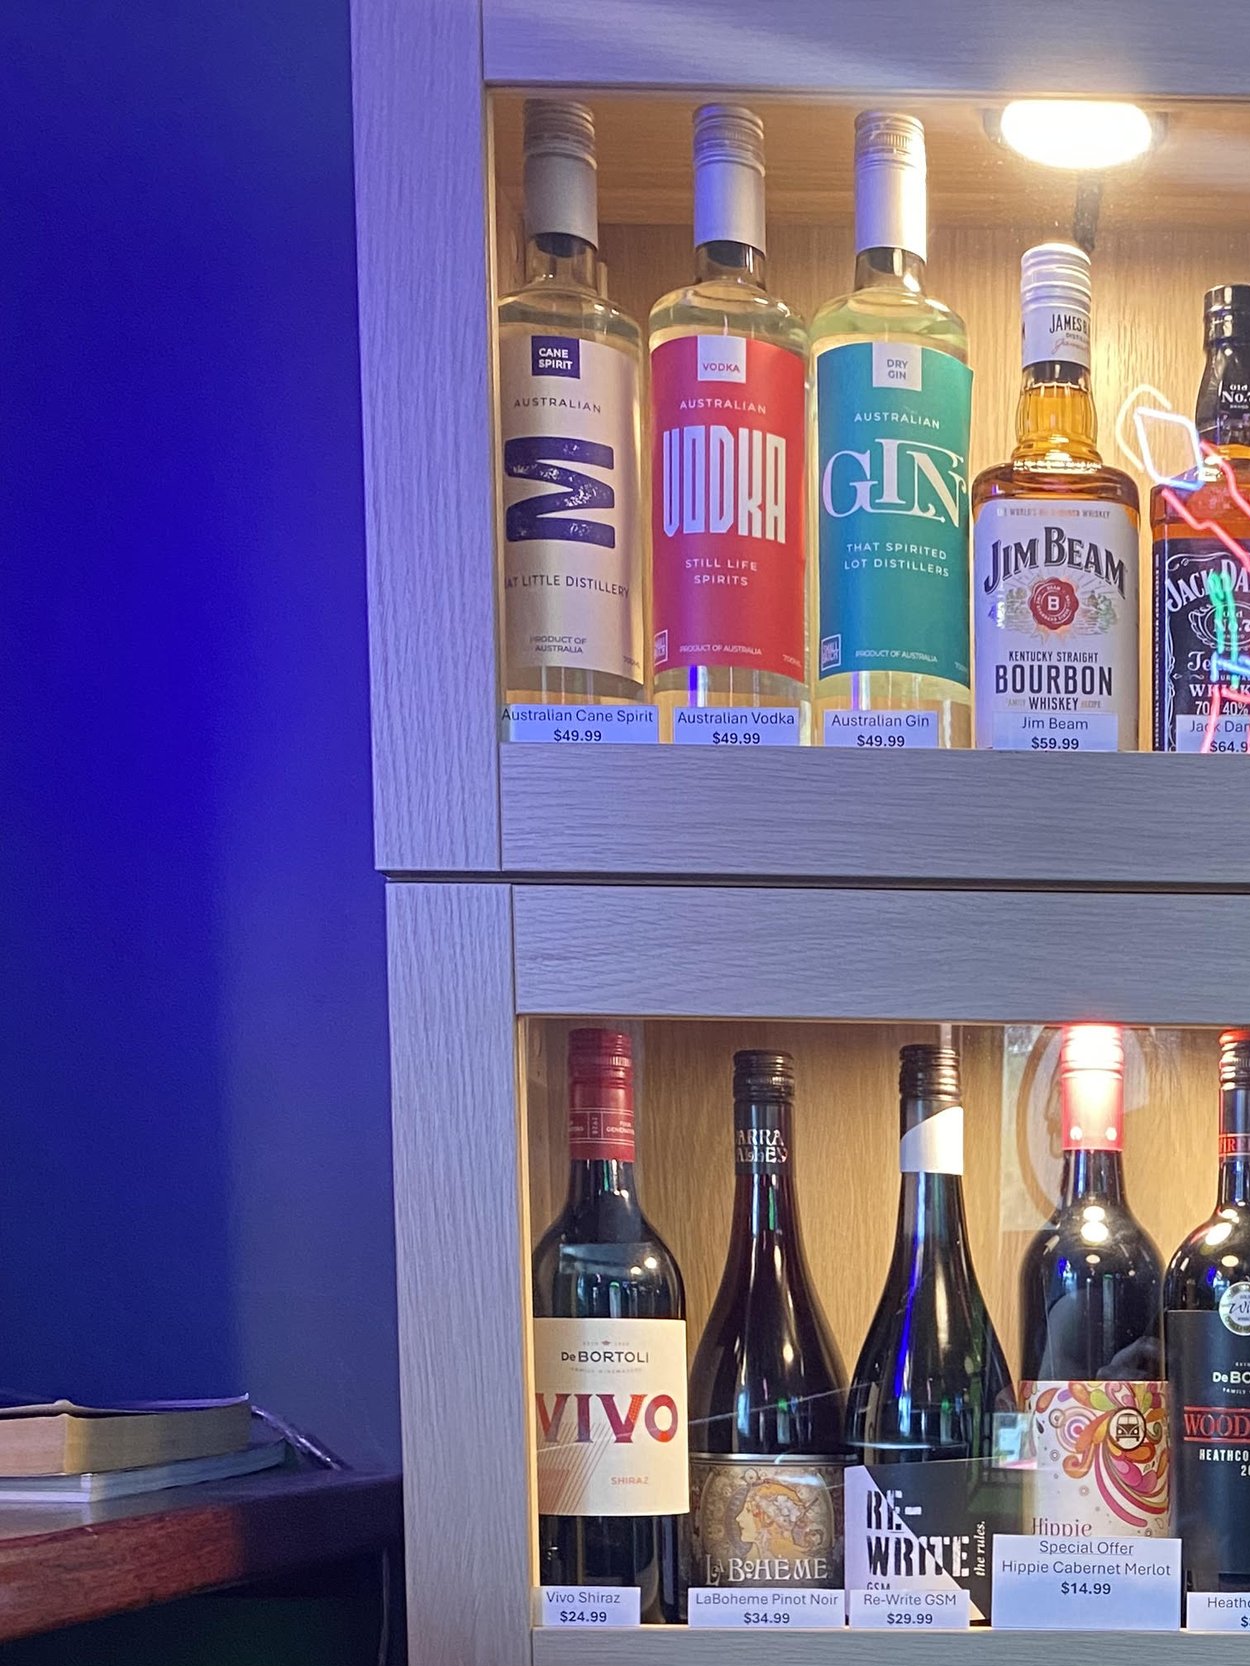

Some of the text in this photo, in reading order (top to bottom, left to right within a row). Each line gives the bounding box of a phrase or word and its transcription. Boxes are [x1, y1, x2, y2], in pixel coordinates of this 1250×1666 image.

[1049, 313, 1082, 334] JAMES
[539, 347, 569, 360] CANE
[538, 358, 573, 371] SPIRIT
[702, 362, 741, 374] VODKA
[886, 358, 909, 370] DRY
[887, 370, 908, 381] GIN
[513, 396, 602, 414] AUSTRALIAN
[679, 397, 768, 415] AUSTRALIAN
[853, 411, 941, 430] AUSTRALIAN
[662, 424, 787, 544] VODKA
[822, 438, 967, 528] GIN
[846, 541, 947, 561] THAT SPIRITED
[684, 558, 758, 572] STILL LIFE
[844, 558, 950, 578] LOT DISTILLERS
[983, 525, 1126, 600] JIM BEAM
[522, 574, 630, 599] LITTLE DISTILLERY
[693, 574, 749, 588] SPIRITS
[1008, 650, 1099, 664] KENTUCKY STRAIGHT
[995, 664, 1113, 696] BOURBON
[1029, 697, 1079, 711] WHISKEY
[501, 708, 654, 725] Australian Cane Spirit
[677, 711, 795, 725] Australian Vodka
[831, 714, 930, 727] Australian Gin
[1021, 717, 1089, 731] Jim Beam
[553, 729, 602, 743] $49.99
[712, 731, 761, 745] $49.99
[856, 735, 905, 748] $49.99
[1031, 736, 1080, 751] $59.99
[535, 1392, 679, 1444] VIVO
[610, 1476, 649, 1486] SHIRAZ
[973, 1520, 986, 1577] the rules.
[866, 1535, 970, 1578] WRITE
[1002, 1560, 1171, 1576] Hippie Cabernet Merlot
[1061, 1581, 1111, 1596] $14.99
[546, 1591, 621, 1604] Vivo Shiraz
[559, 1610, 608, 1624] $24.99
[743, 1612, 790, 1625] $34.99
[886, 1613, 933, 1625] $29.99
